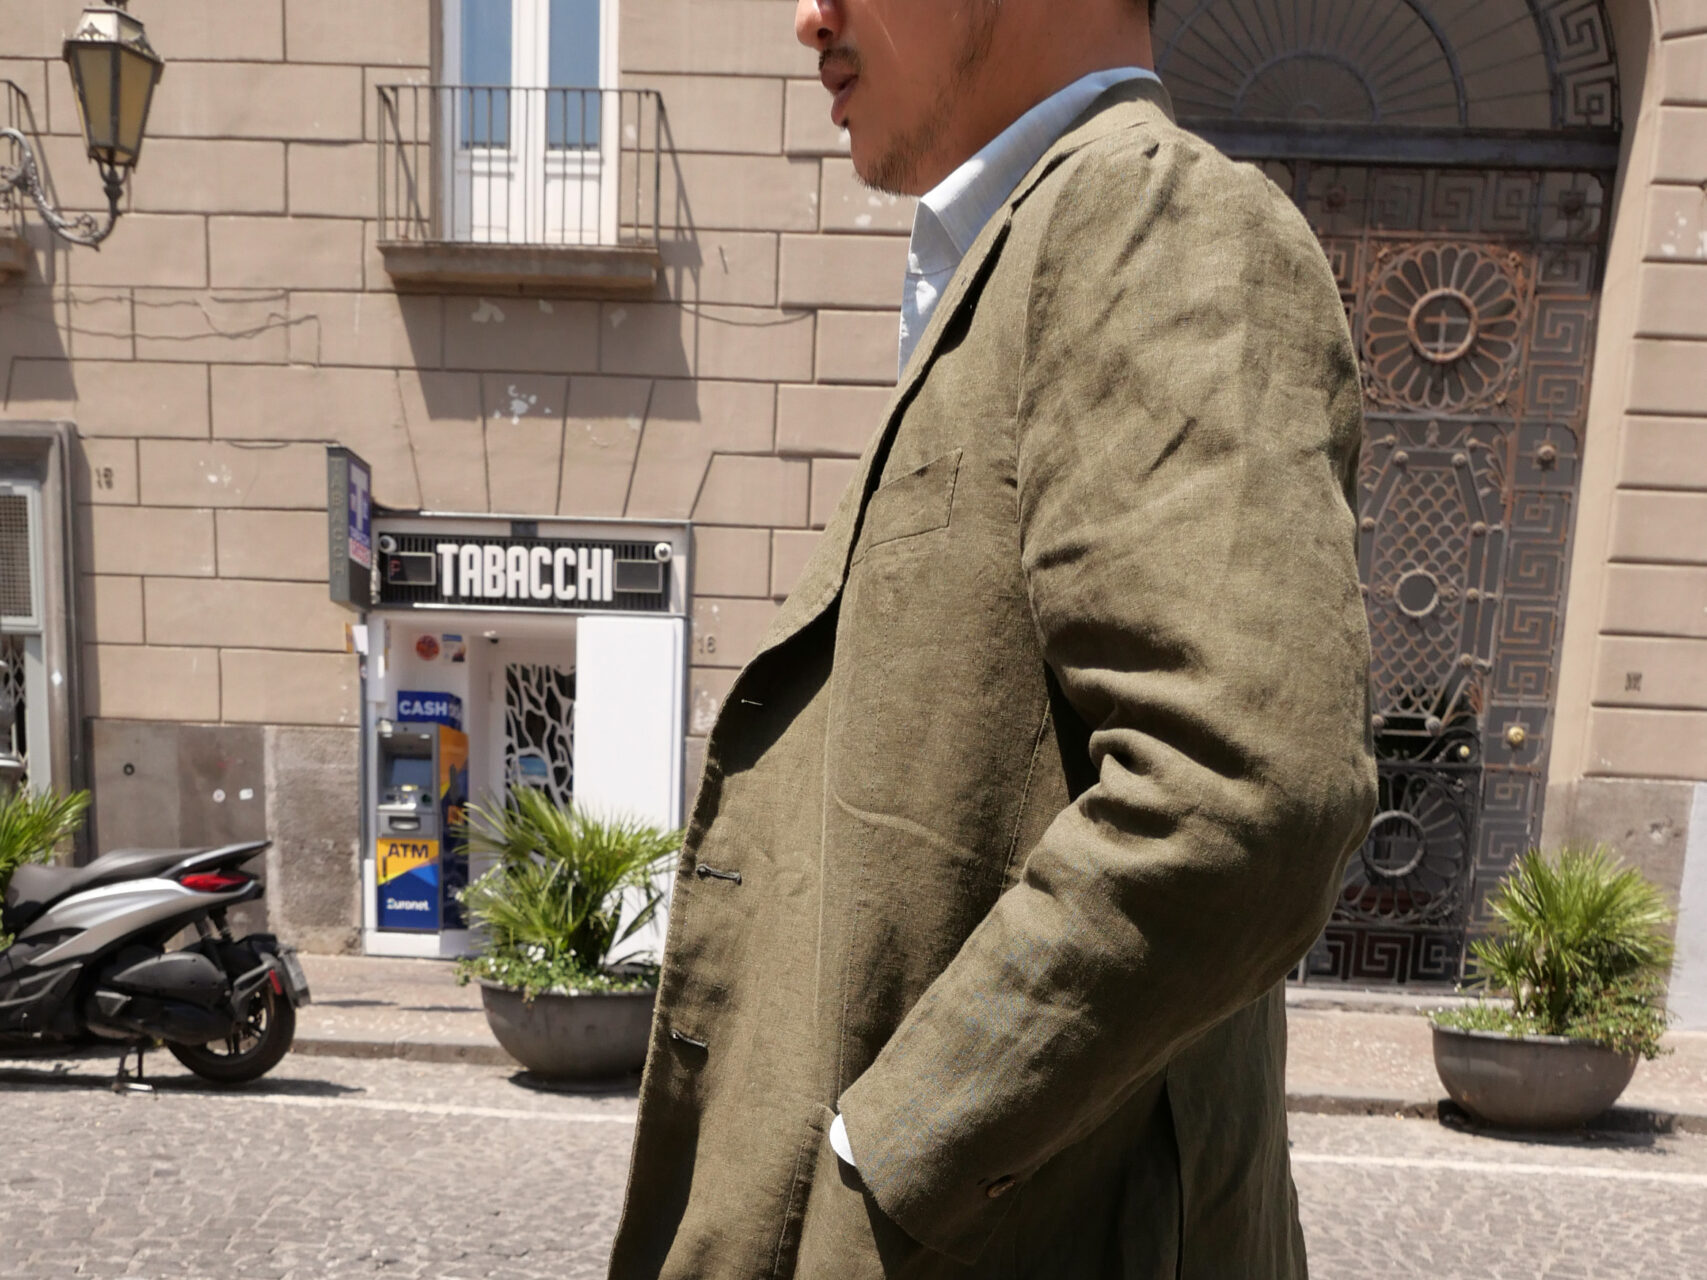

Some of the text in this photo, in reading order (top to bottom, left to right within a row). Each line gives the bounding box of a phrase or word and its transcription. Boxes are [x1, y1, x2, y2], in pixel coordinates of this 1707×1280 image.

[437, 543, 614, 601] TABACCHI
[399, 700, 448, 716] CASH
[387, 843, 429, 858] ATM
[386, 898, 430, 911] Euronet
